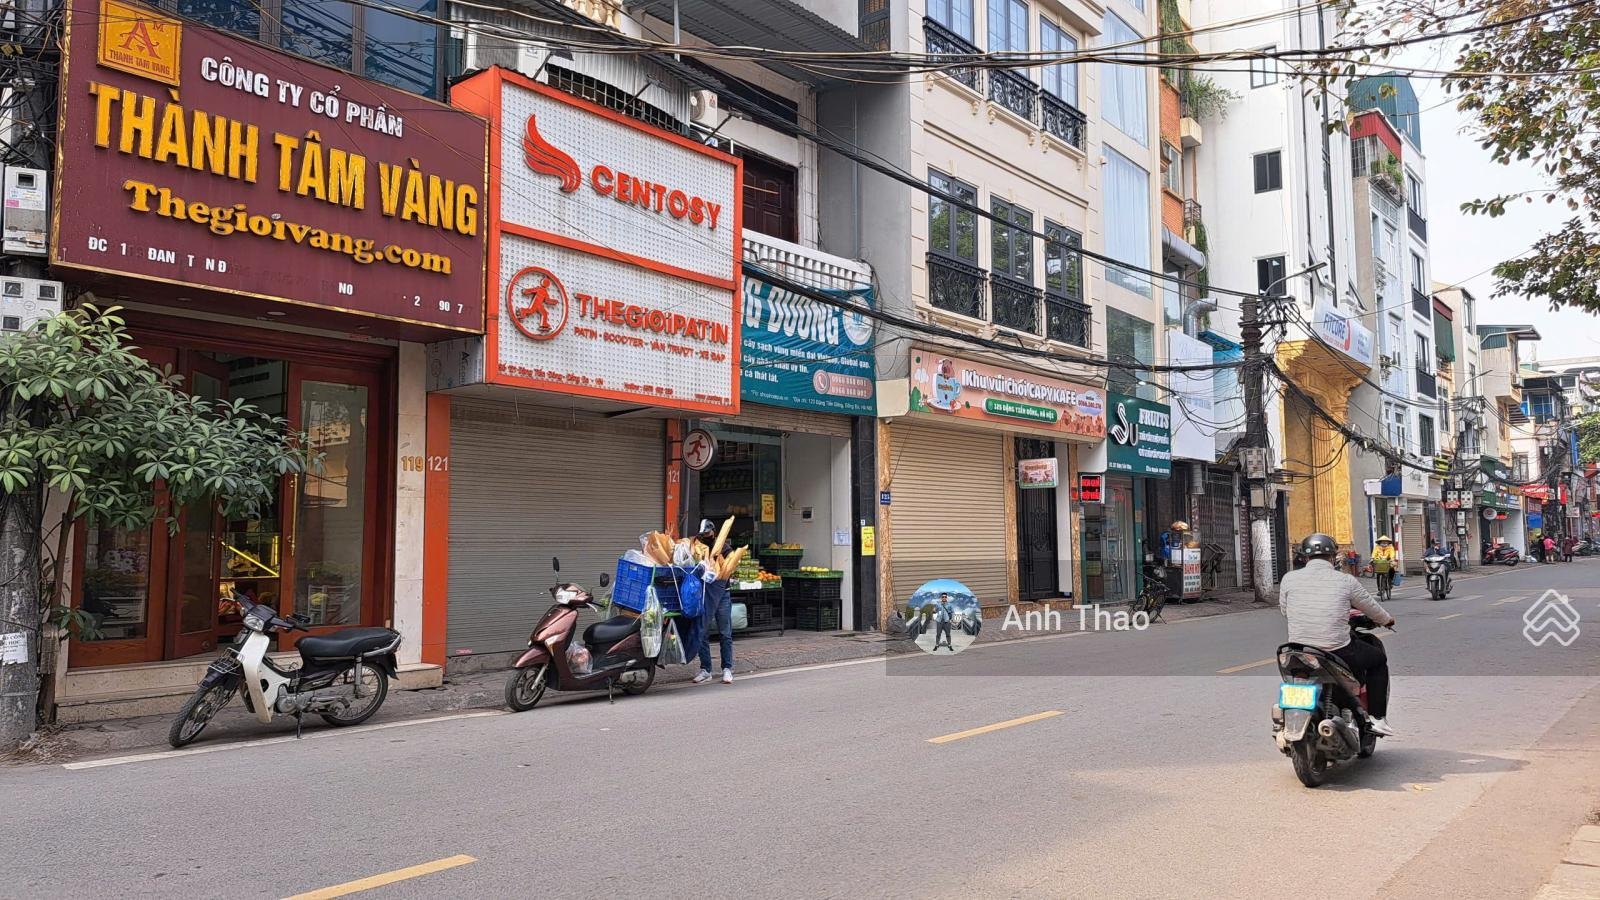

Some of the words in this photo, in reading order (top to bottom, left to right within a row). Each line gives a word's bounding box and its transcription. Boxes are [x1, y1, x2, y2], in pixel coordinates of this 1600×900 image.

[201, 55, 269, 99] CÔNG
[277, 79, 303, 108] TY
[309, 85, 341, 119] CỔ
[346, 95, 404, 138] PHẦN
[89, 81, 259, 184] THÀNH
[274, 129, 366, 210] TÂM
[379, 158, 478, 237] VÀNG
[590, 164, 721, 231] CENTOSY
[122, 179, 453, 276] Thegioivang.com
[961, 369, 987, 389] Khu
[1138, 408, 1170, 429] FRUITS
[401, 455, 424, 472] 119
[427, 455, 449, 472] 121
[668, 469, 681, 483] 121
